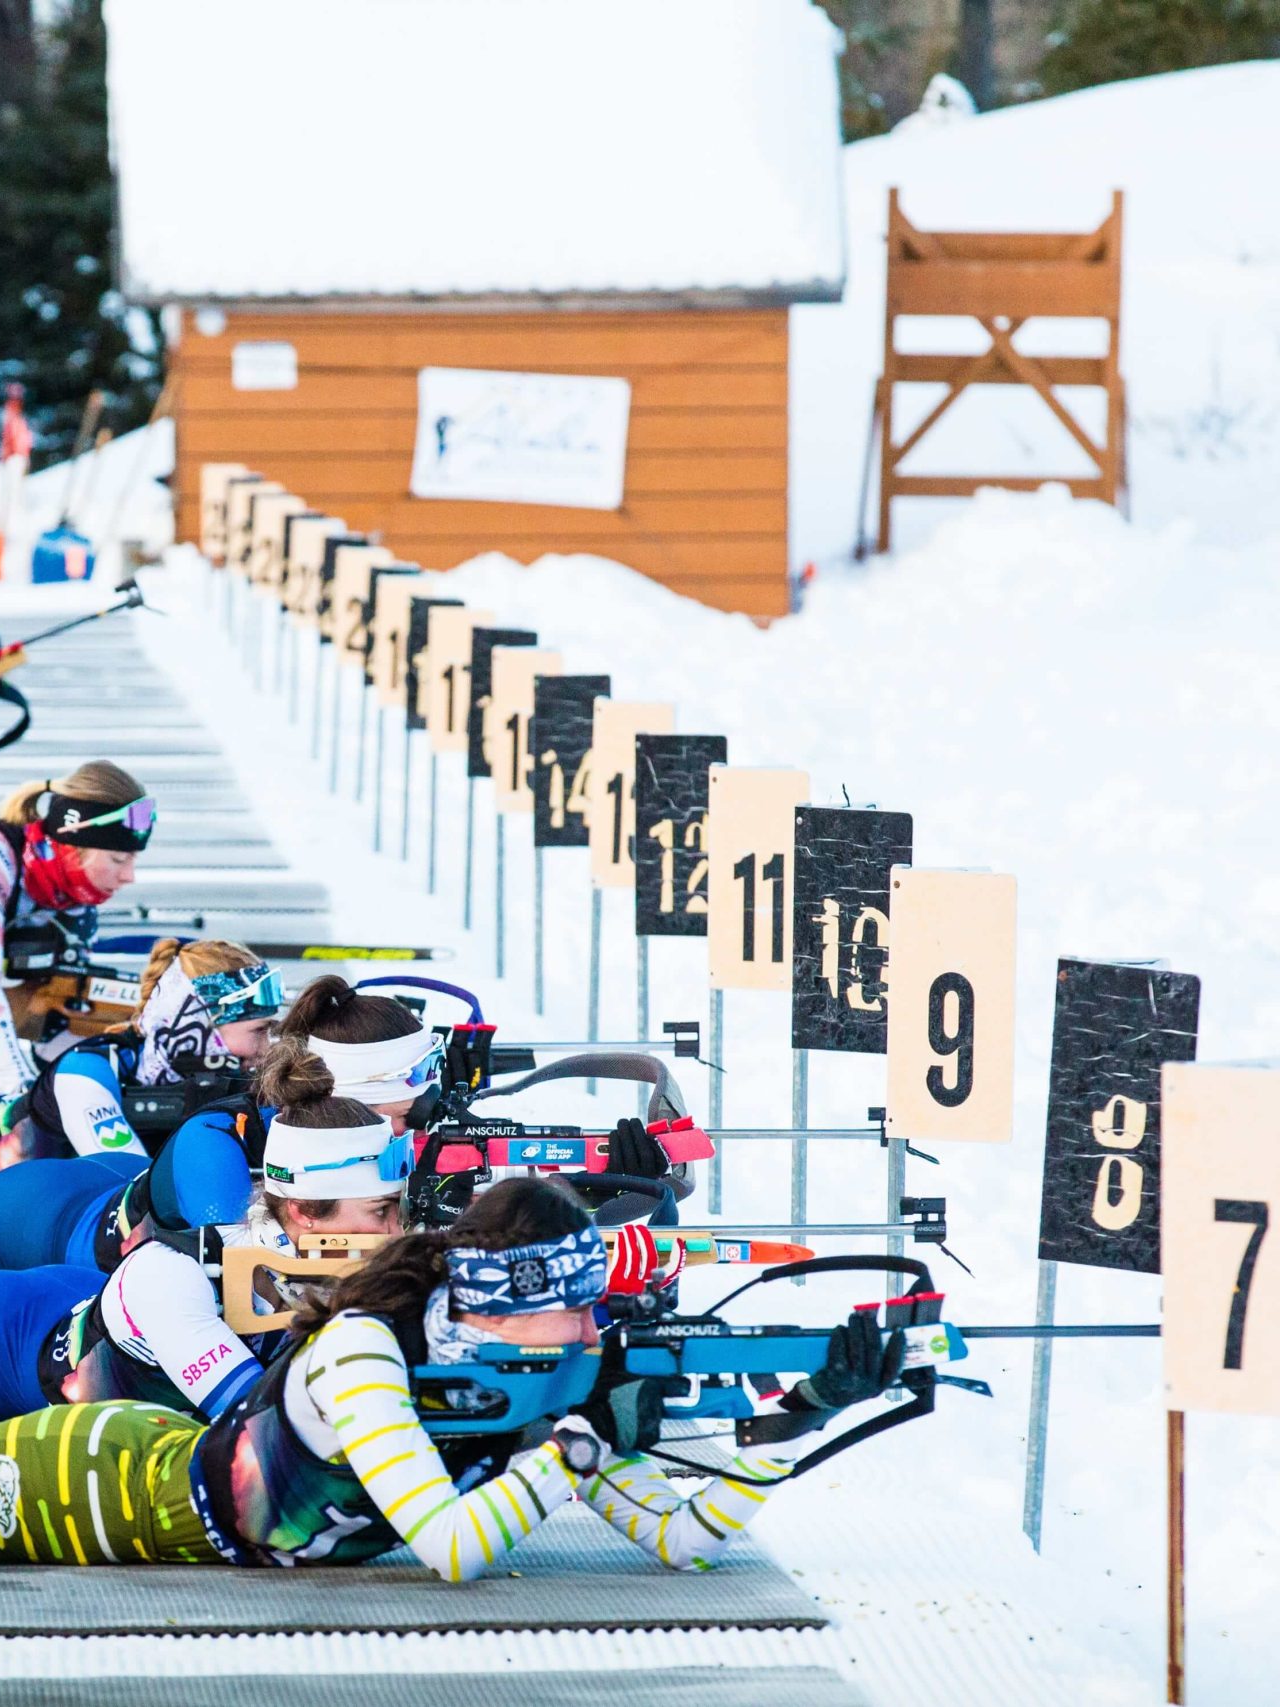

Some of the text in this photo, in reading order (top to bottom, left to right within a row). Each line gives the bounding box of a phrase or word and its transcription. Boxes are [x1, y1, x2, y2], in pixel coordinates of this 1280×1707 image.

[733, 852, 785, 963] 11
[925, 971, 975, 1107] 9
[1091, 1094, 1148, 1231] 8
[1214, 1197, 1269, 1371] 7
[181, 1343, 232, 1387] SBSTA
